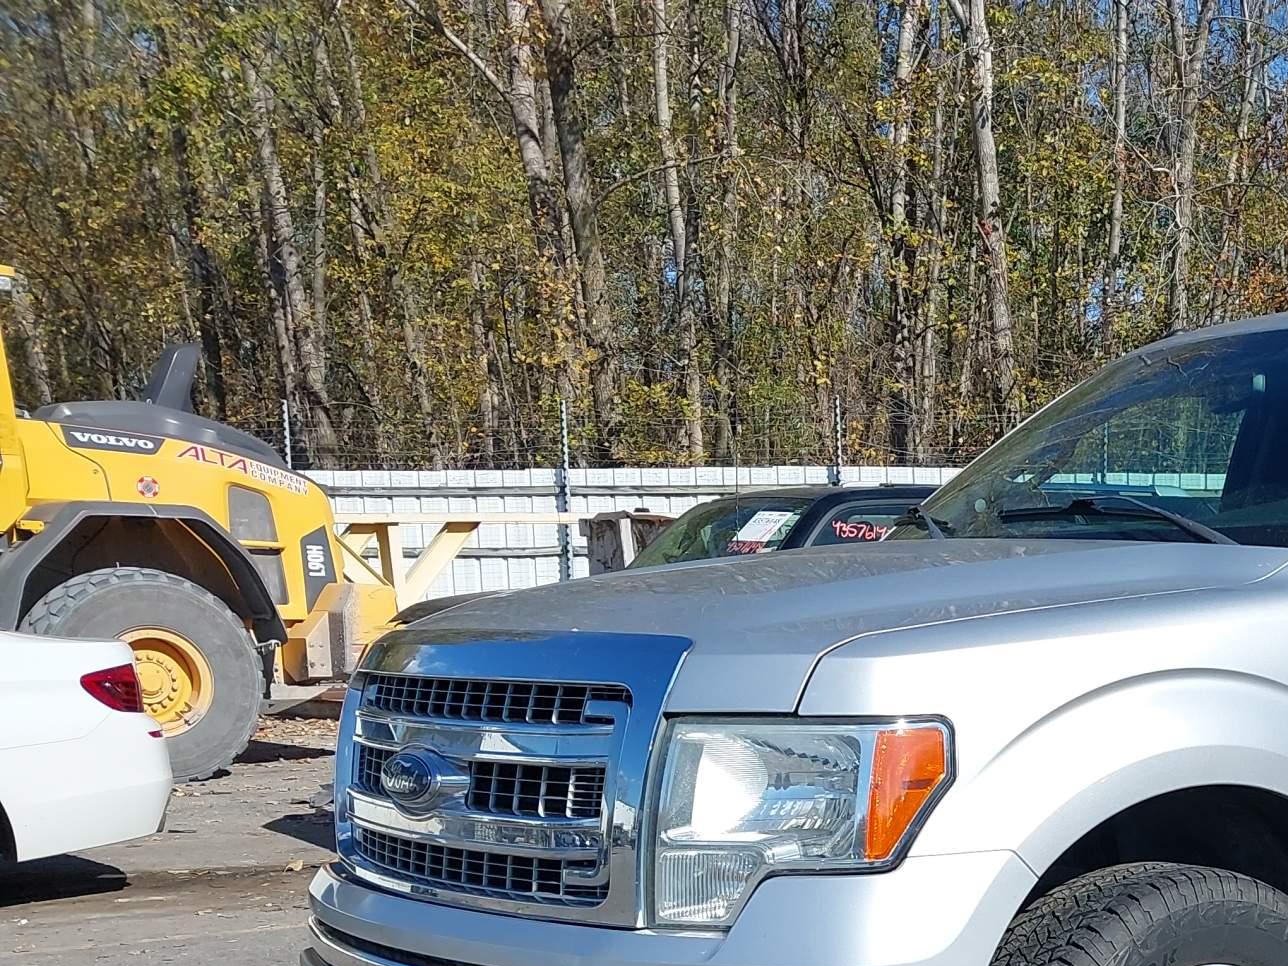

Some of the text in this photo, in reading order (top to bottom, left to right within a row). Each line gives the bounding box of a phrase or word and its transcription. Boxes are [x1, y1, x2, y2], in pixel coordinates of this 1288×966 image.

[70, 431, 155, 449] VOLVO
[177, 446, 250, 474] ALTA
[249, 461, 308, 487] EQUIPMENT
[250, 469, 309, 496] COMPANY
[305, 544, 326, 577] L90H
